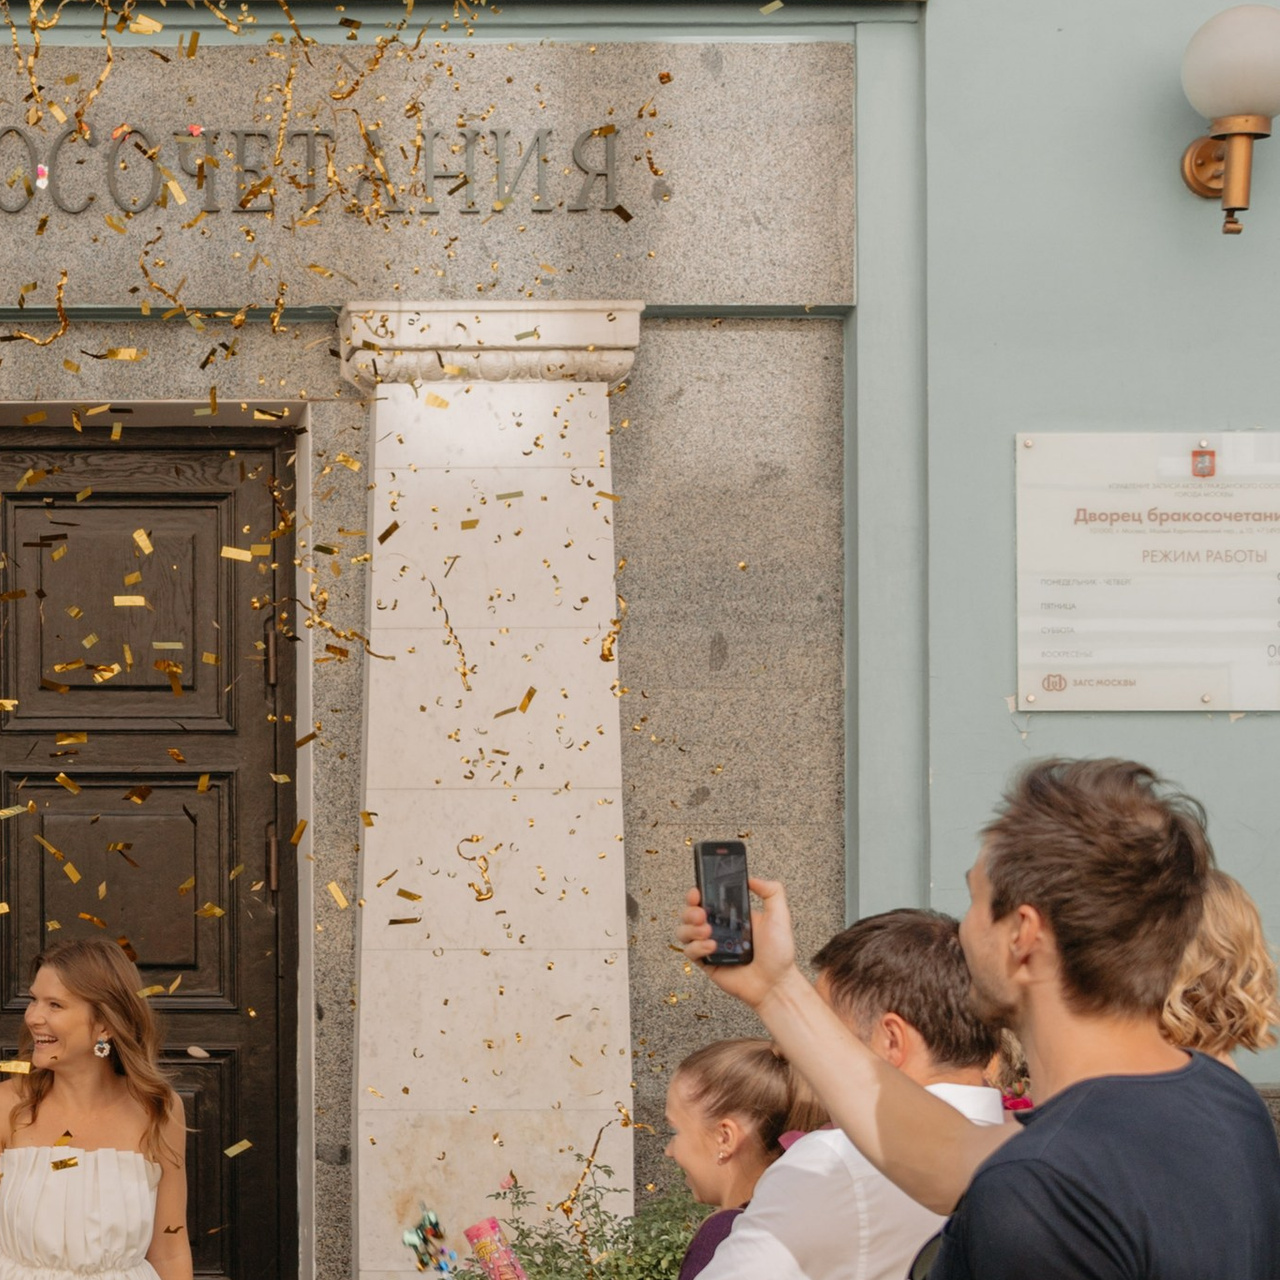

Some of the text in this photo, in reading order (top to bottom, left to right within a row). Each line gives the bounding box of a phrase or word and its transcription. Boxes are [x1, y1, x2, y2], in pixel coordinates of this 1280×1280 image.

[1074, 508, 1143, 526] Дворец
[1142, 549, 1268, 563] РЕЖИМ РАБОТЫ
[1072, 679, 1136, 687] ЗАГС МОСКВЫ
